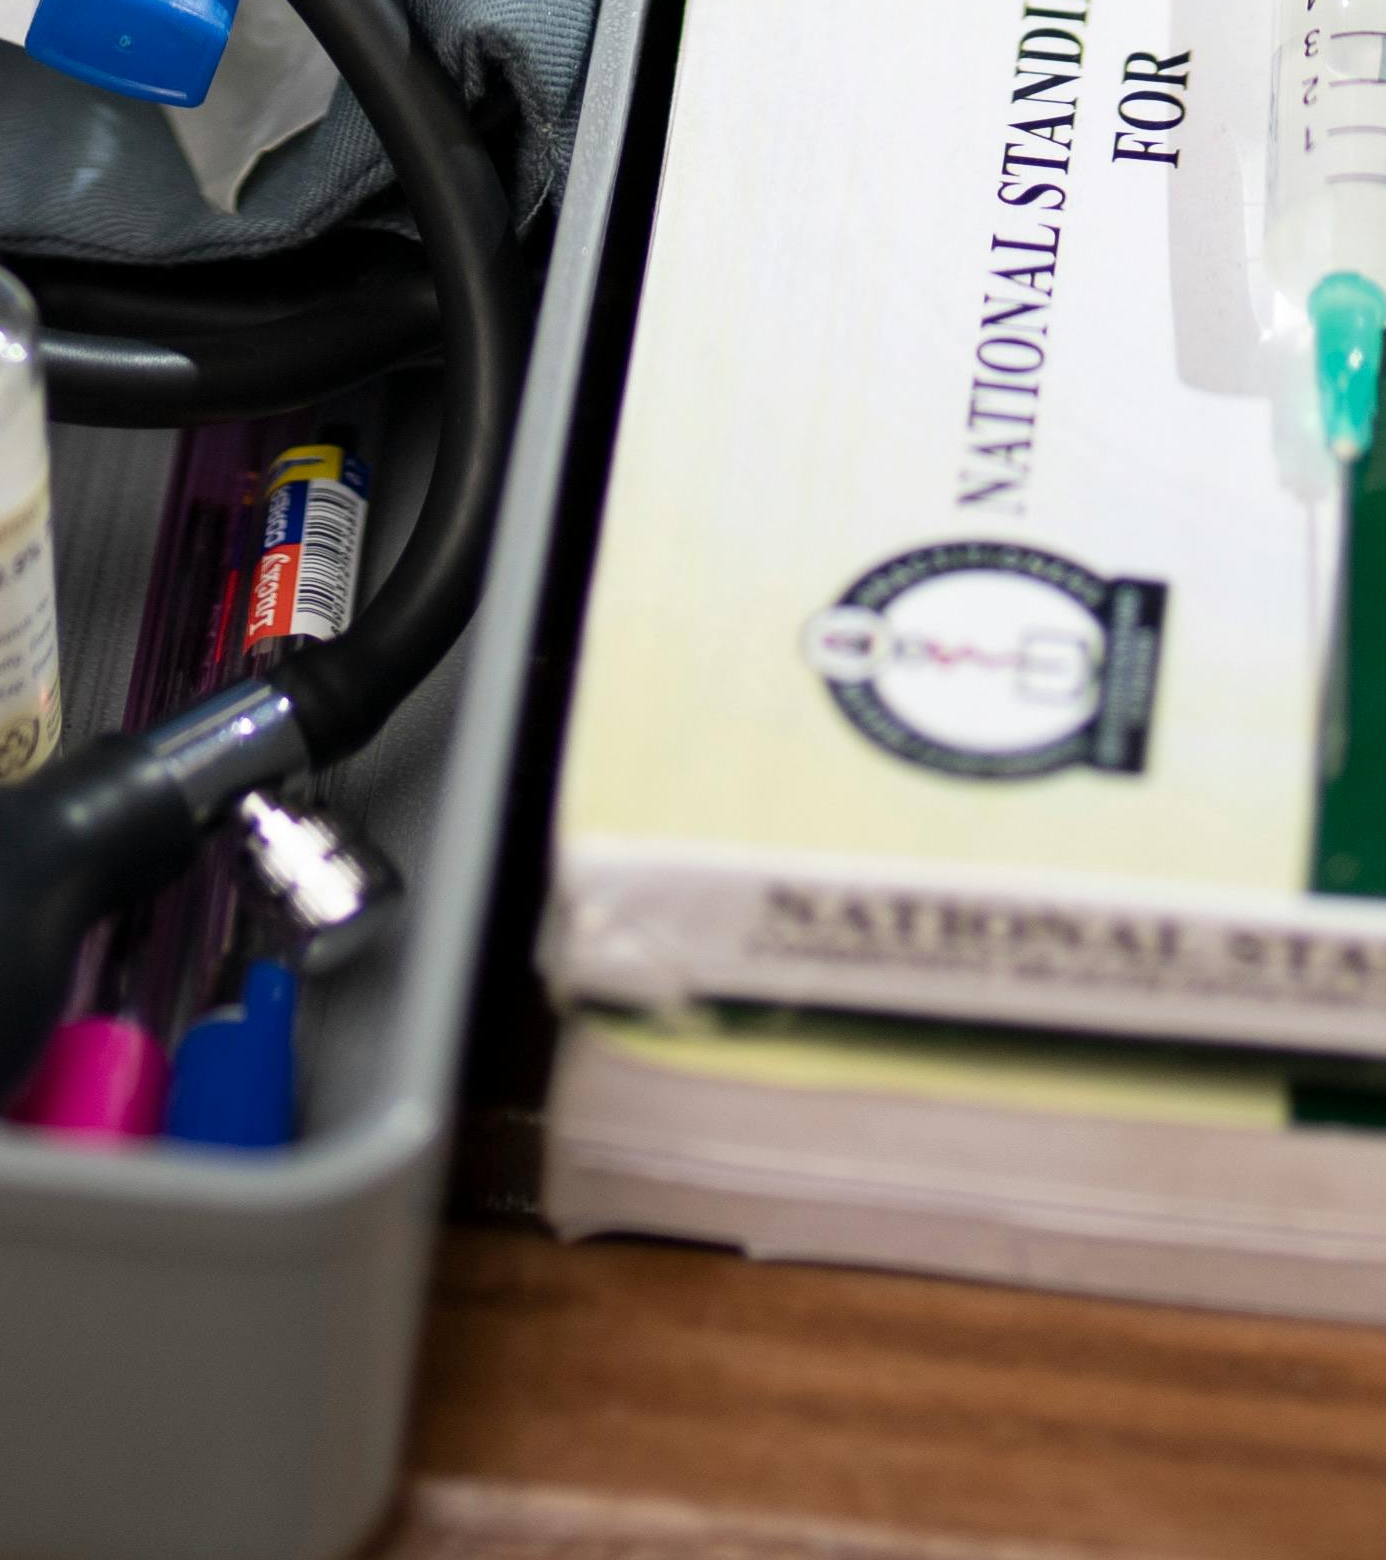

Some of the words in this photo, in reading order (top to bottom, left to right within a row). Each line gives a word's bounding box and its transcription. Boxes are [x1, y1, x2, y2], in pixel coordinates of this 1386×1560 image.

[1112, 49, 1192, 169] FOR
[956, 222, 1062, 516] NATIONAL
[249, 552, 292, 637] Lucky
[766, 882, 1182, 965] NATIONAL
